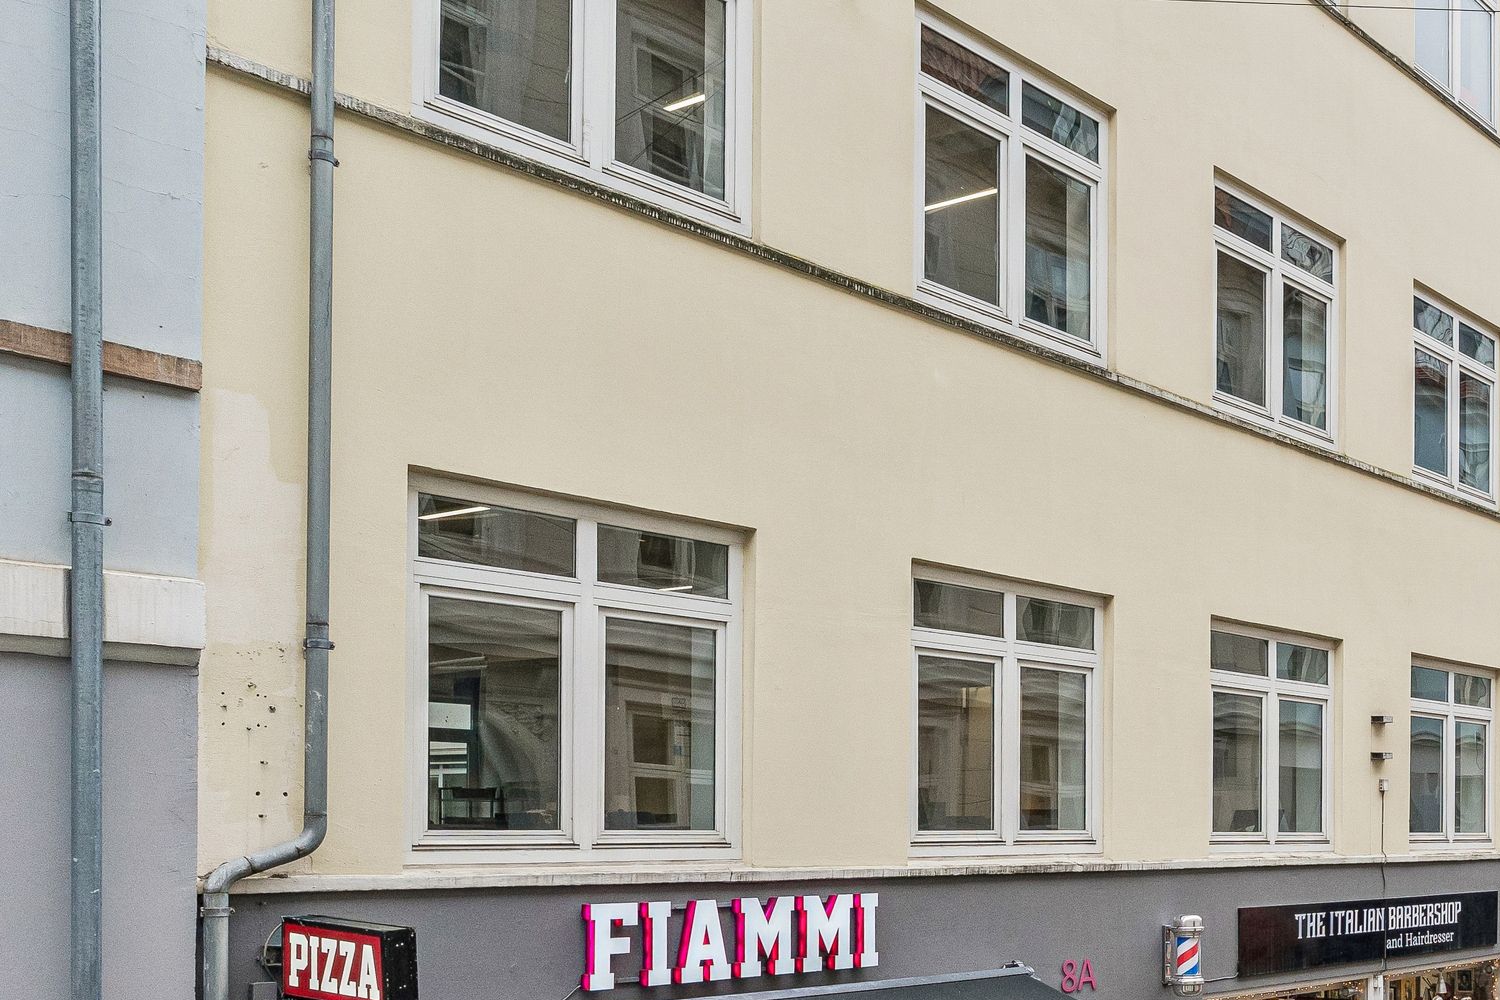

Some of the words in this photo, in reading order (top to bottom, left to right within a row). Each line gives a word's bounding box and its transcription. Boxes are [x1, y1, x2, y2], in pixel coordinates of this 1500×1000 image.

[1294, 912, 1326, 939] THE
[1328, 907, 1385, 936] ITALIAN
[1388, 901, 1462, 931] BARBERSHOP
[581, 893, 879, 991] FIAMMI
[1386, 933, 1403, 949] and
[1405, 930, 1455, 947] Hairdresser
[288, 932, 381, 1000] PIZZA
[1061, 957, 1097, 993] 8A
